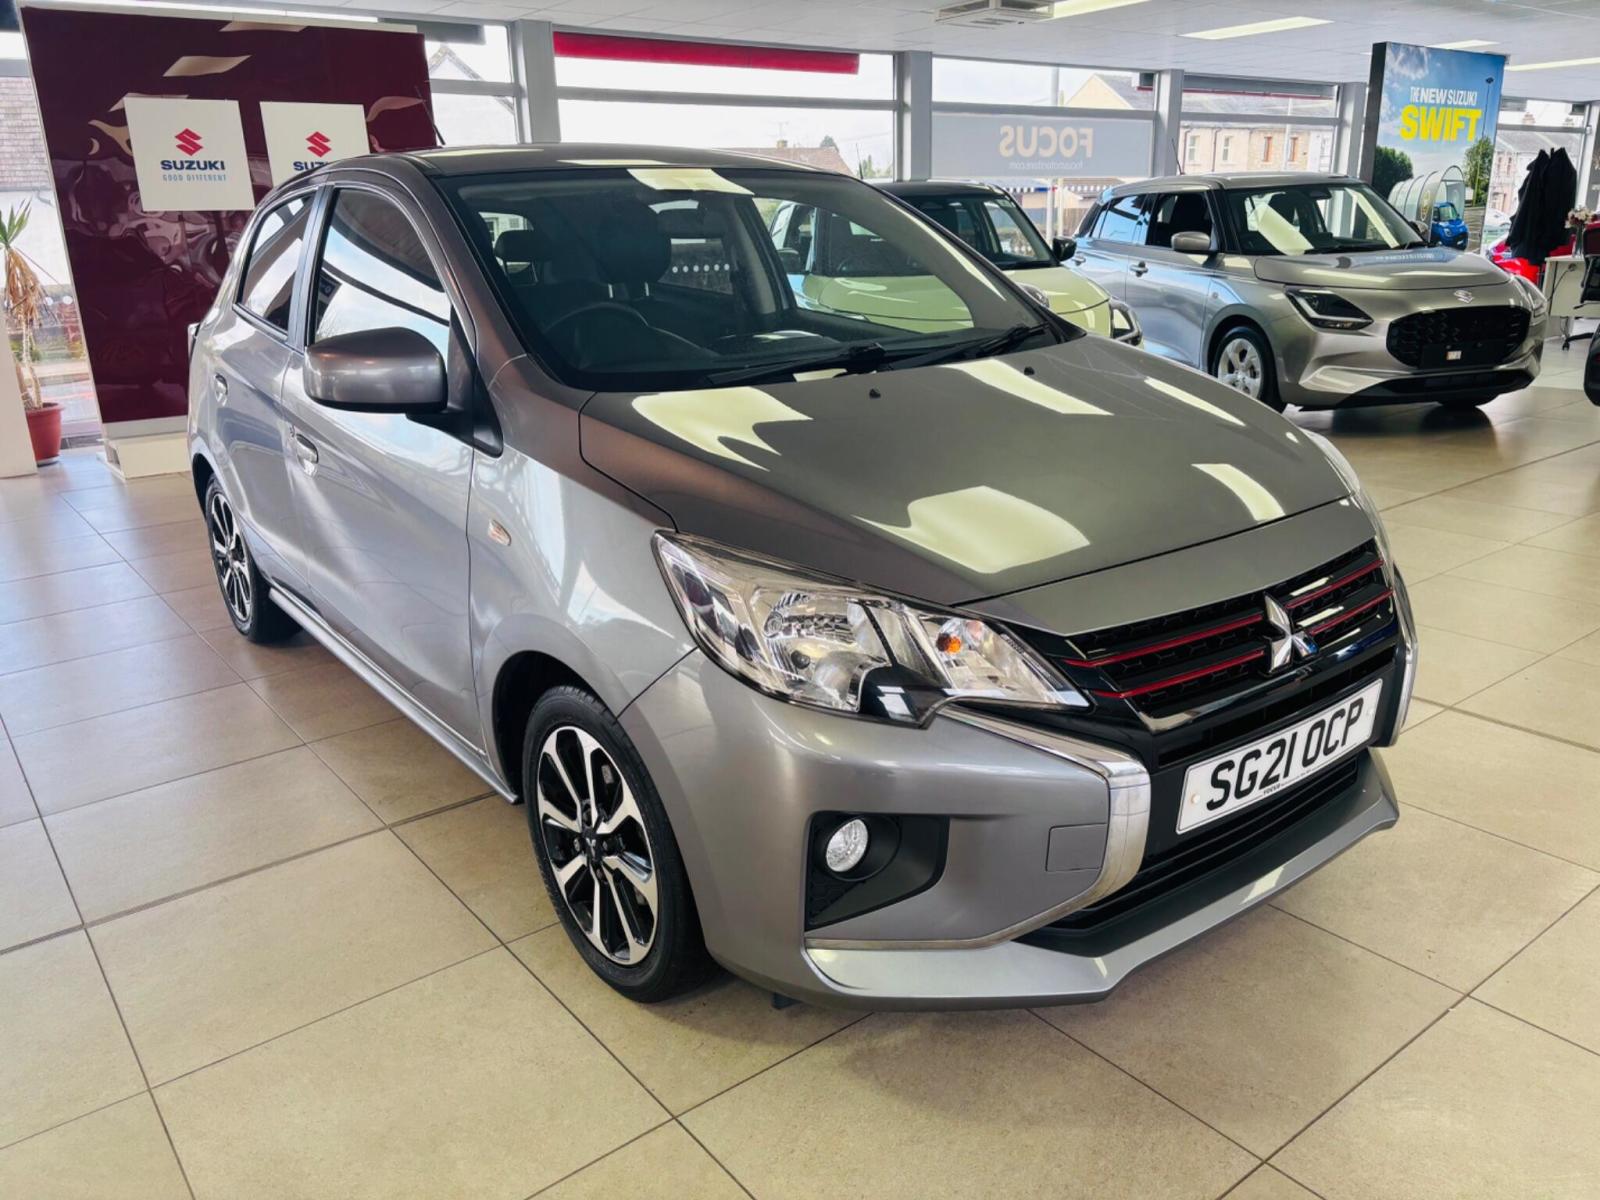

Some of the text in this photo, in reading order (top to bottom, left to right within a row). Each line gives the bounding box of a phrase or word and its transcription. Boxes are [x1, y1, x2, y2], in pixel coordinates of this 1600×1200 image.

[1420, 87, 1447, 105] NEW
[1447, 89, 1478, 106] SUZUKI
[1400, 105, 1482, 141] SWIFT
[160, 160, 225, 170] SUZUKI
[1206, 698, 1364, 811] SG21 OCP
